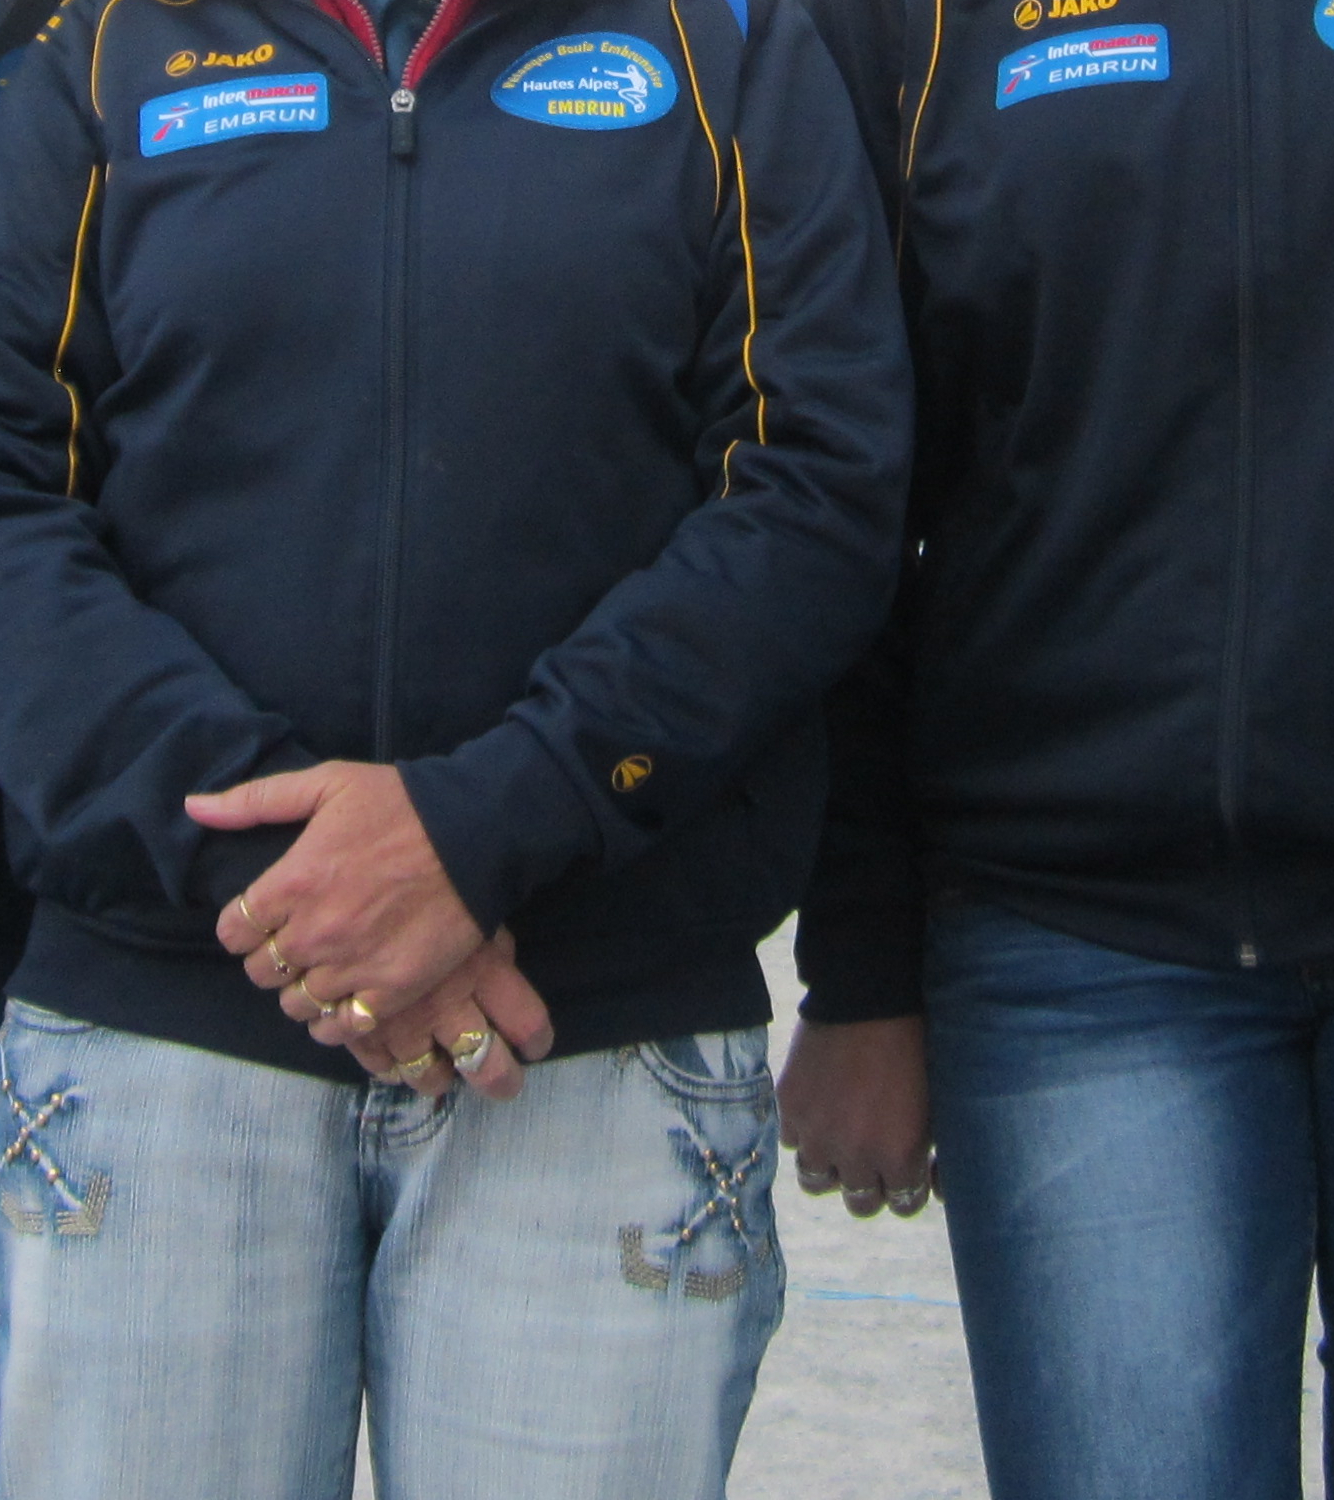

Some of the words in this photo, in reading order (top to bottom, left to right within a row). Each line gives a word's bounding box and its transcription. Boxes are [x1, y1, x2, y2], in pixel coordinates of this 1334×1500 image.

[202, 44, 275, 67] JAKO
[557, 41, 595, 56] Boule
[600, 41, 663, 88] Embrunaise
[1048, 58, 1157, 83] EMBRUN
[523, 78, 574, 92] Hautes
[578, 77, 619, 92] Alpes
[548, 99, 625, 118] EMBRUN
[204, 108, 315, 134] EMBRUN
